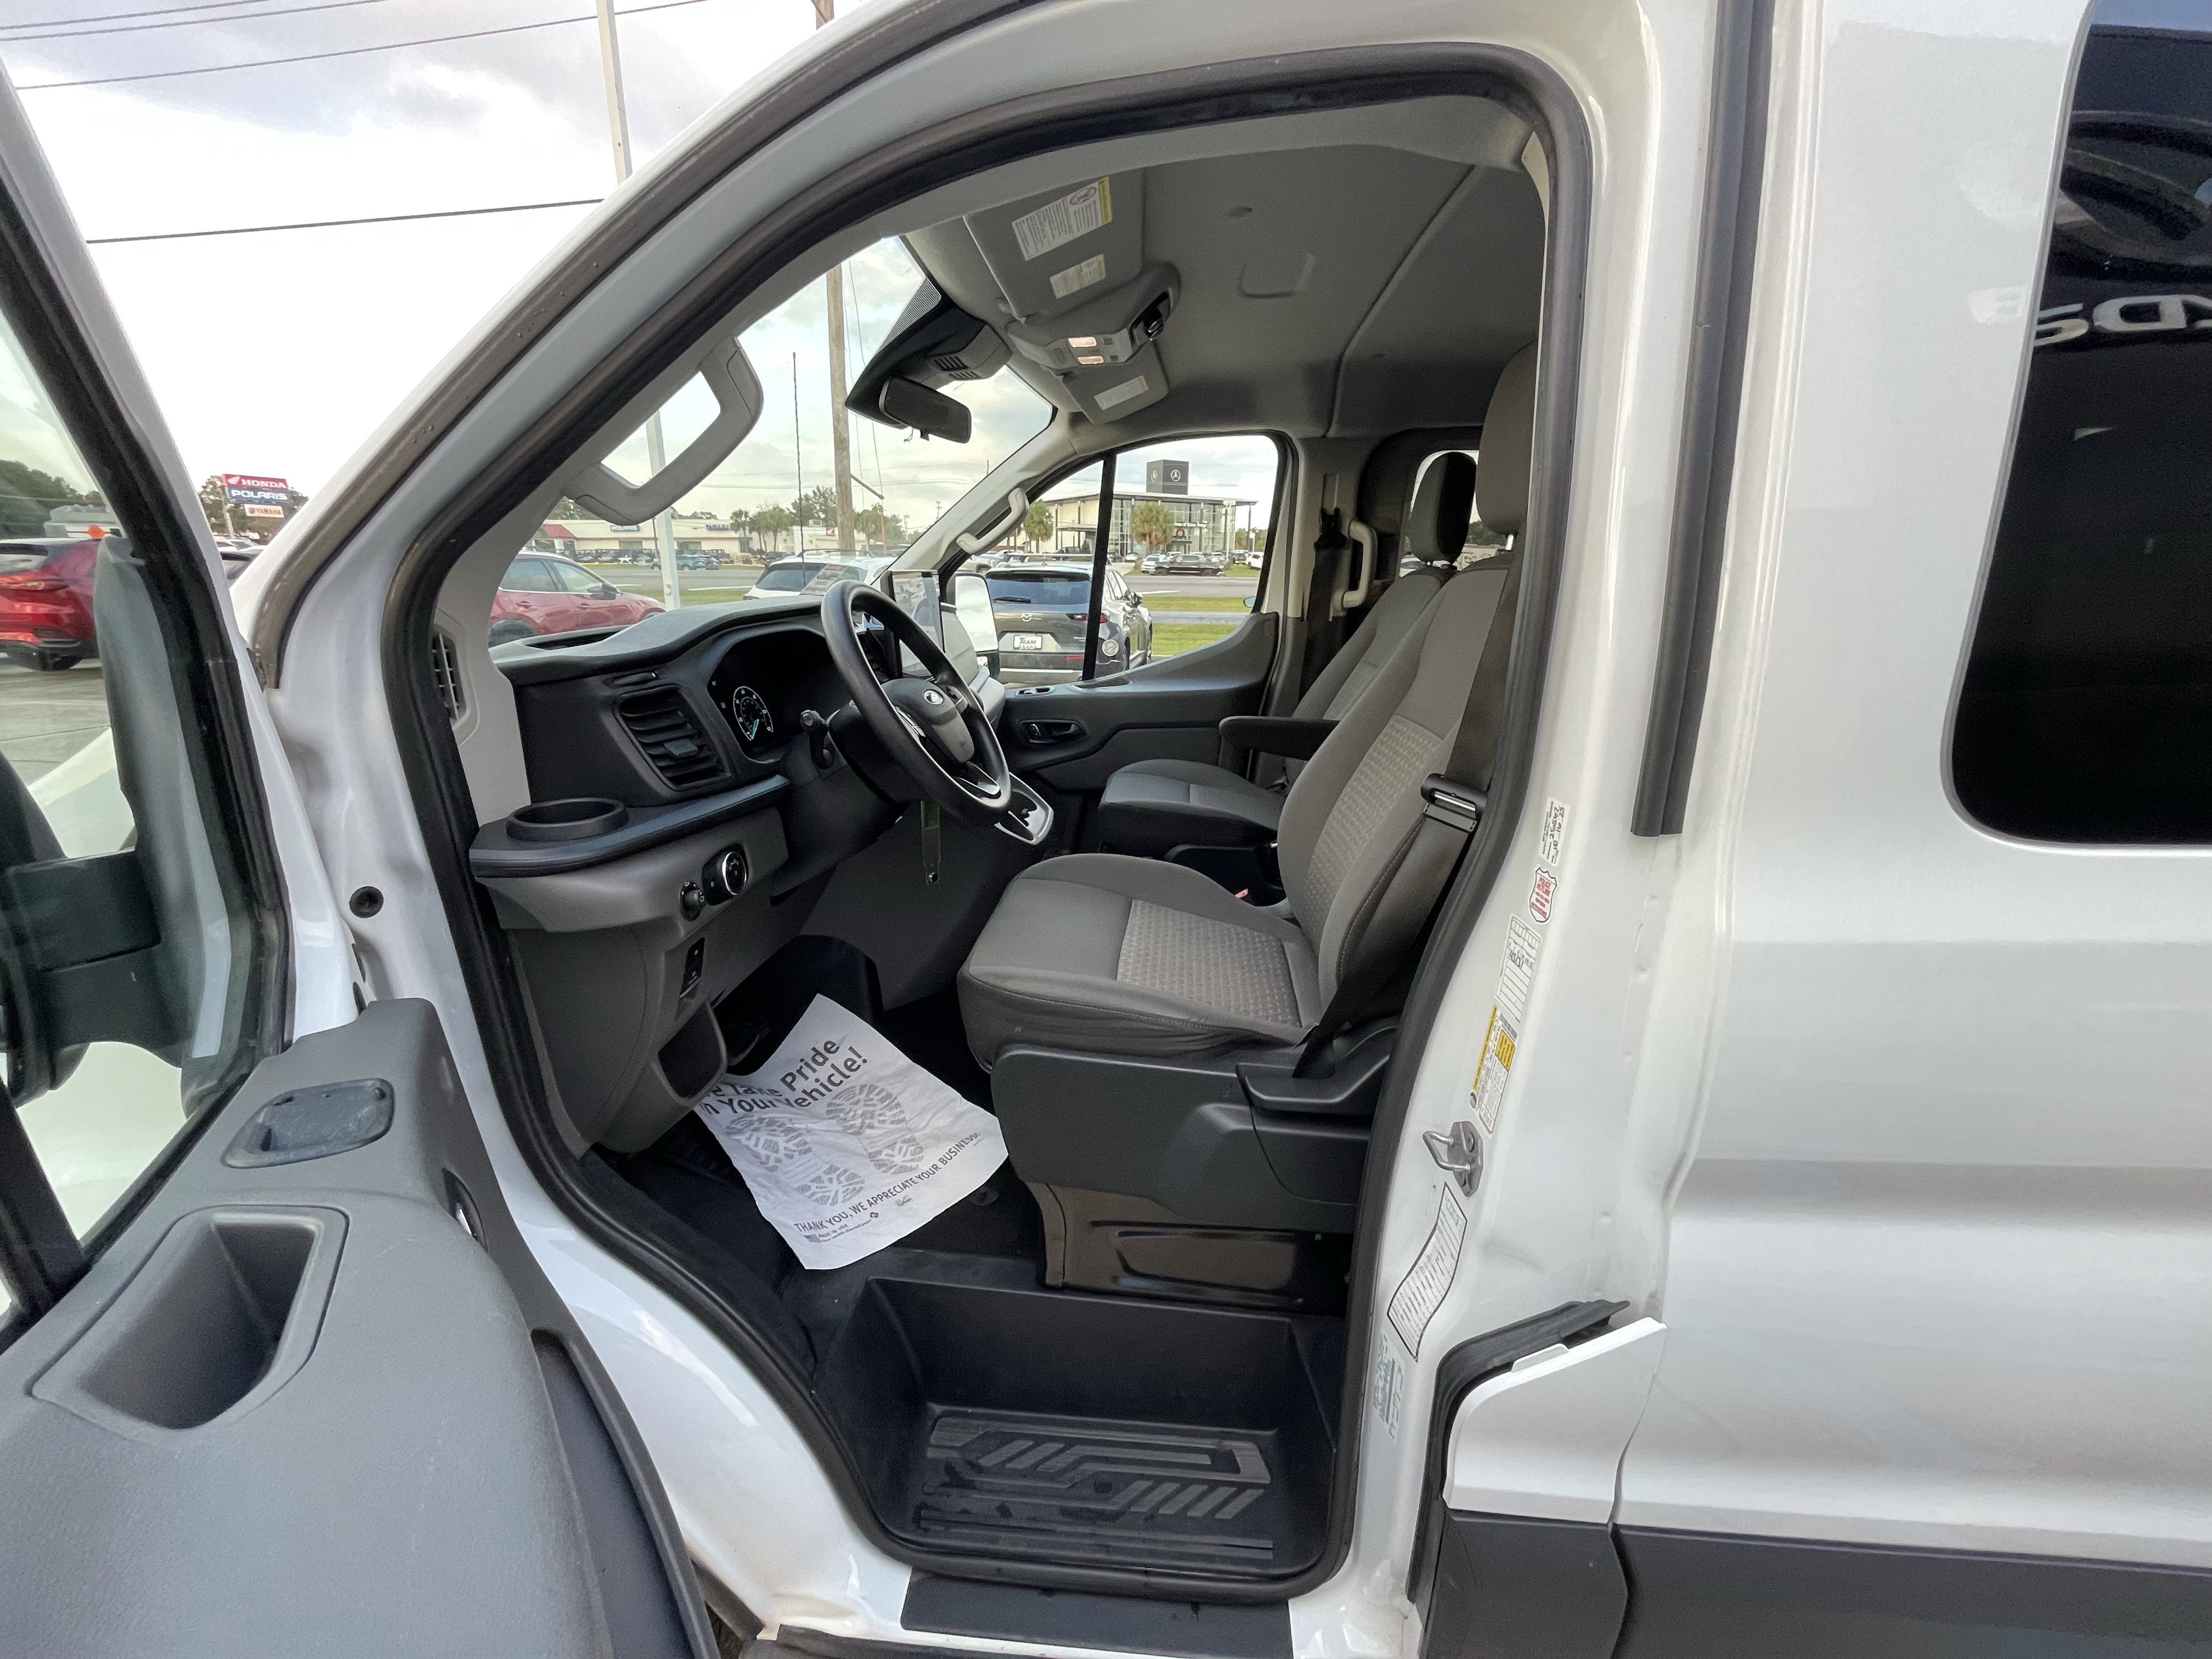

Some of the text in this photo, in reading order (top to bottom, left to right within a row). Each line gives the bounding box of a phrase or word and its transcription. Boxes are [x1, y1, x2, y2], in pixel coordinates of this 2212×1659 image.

[231, 489, 287, 500] POLARIS
[241, 479, 287, 488] HONDA
[774, 1046, 867, 1108] Vehicle!
[780, 1040, 839, 1092] Pride
[794, 1220, 828, 1233] THANK
[825, 1211, 854, 1226] YOU,
[848, 1201, 868, 1214] WE
[866, 1177, 918, 1207] APPRECIATE
[915, 1164, 942, 1182] YOUR
